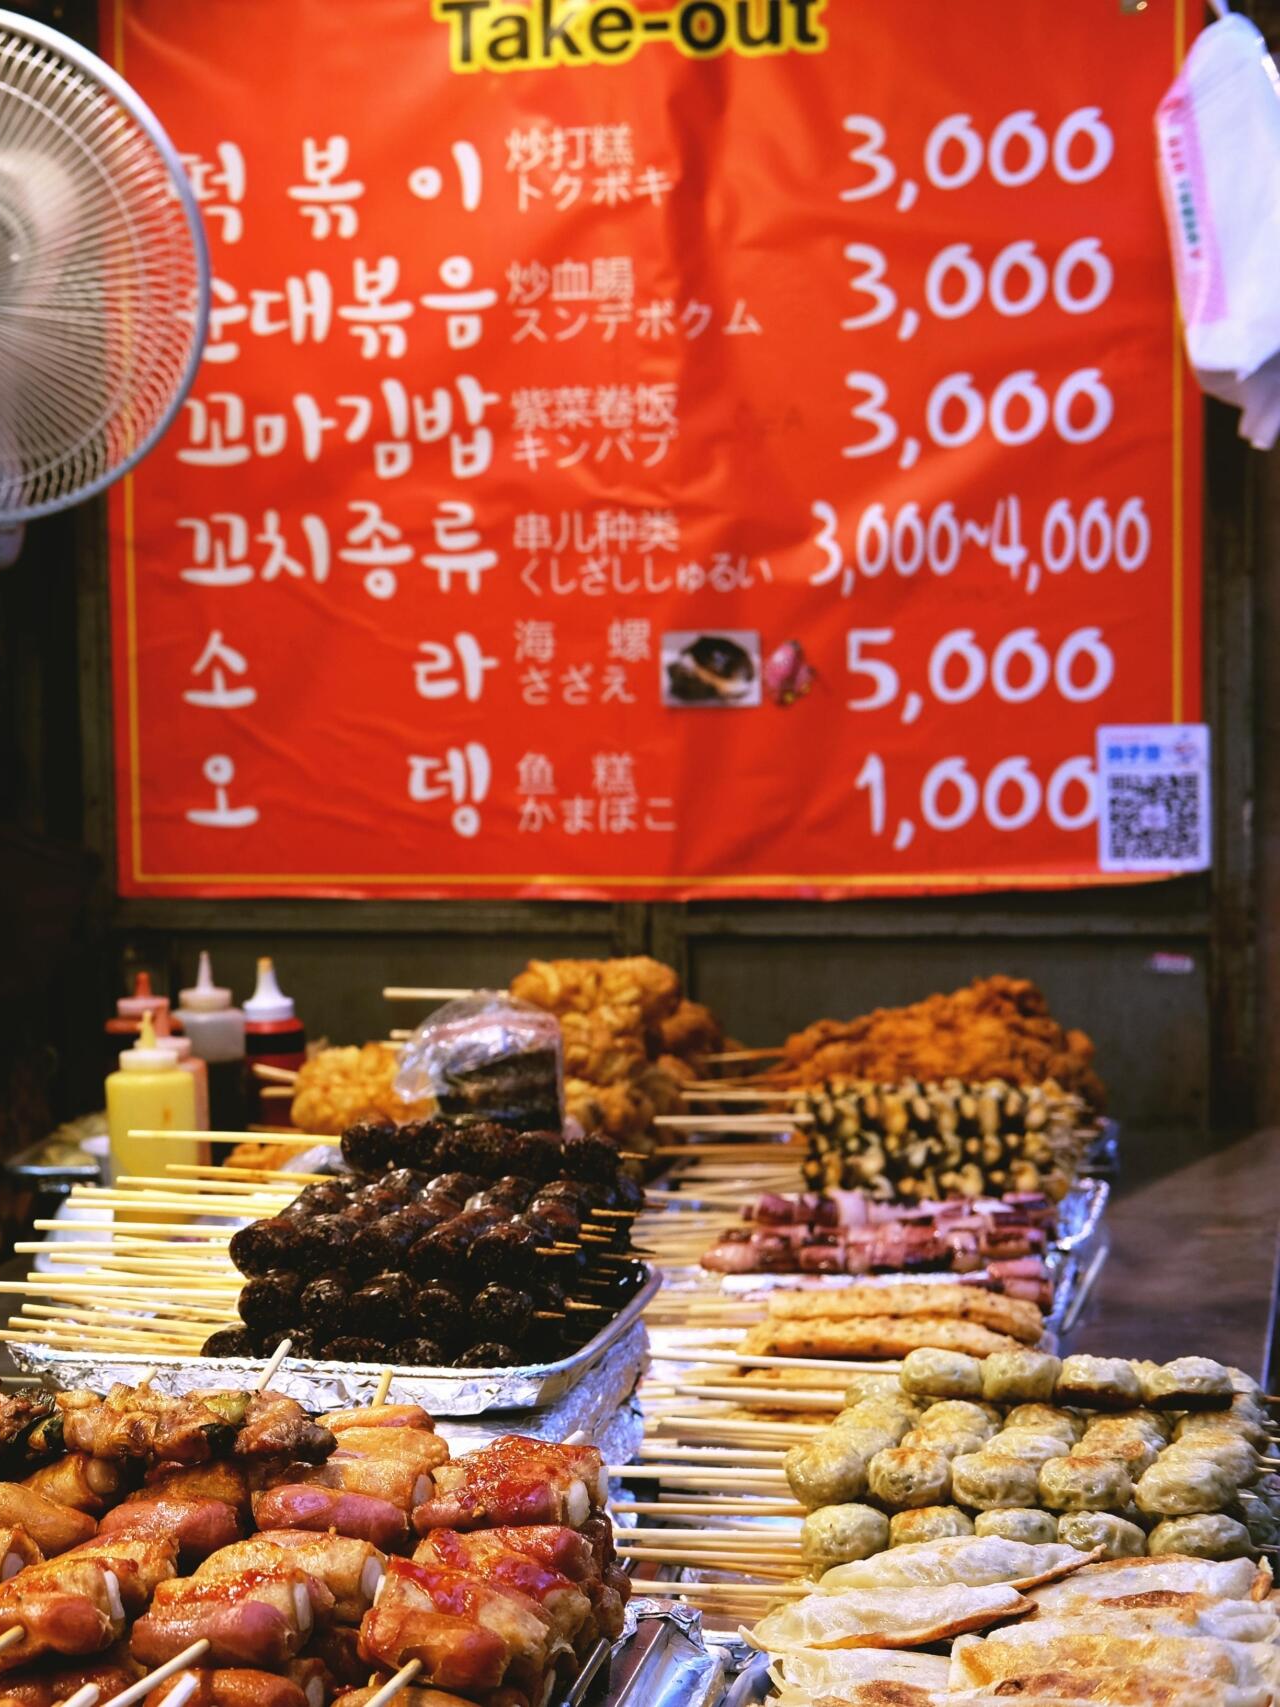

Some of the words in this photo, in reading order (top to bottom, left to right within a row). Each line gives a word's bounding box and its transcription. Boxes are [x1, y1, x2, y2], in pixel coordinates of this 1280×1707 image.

[442, 0, 821, 66] Take-out
[839, 106, 1114, 212] 3,000
[840, 237, 1114, 340] 3,000
[176, 375, 500, 480] 꼬마김밥
[841, 368, 1114, 470] 3,000
[175, 500, 498, 599] 꼬치종류
[846, 626, 1115, 725] 5,000
[854, 752, 1098, 851] 1,000
